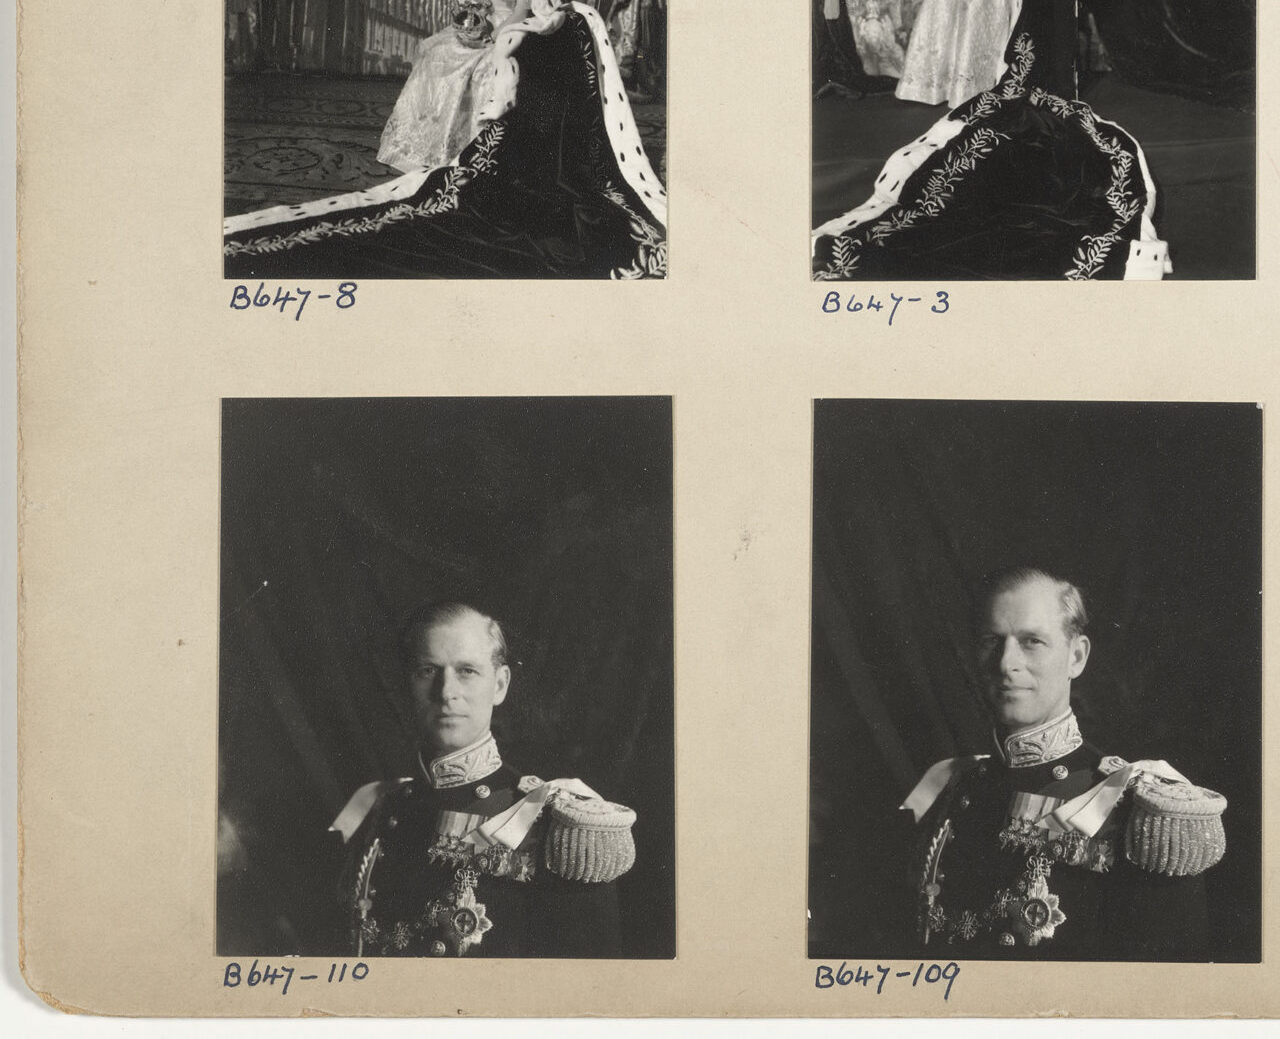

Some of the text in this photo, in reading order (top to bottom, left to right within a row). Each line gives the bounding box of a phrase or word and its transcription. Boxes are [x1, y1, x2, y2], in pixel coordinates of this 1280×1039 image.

[230, 282, 358, 322] B647-8
[822, 291, 950, 327] B647-3
[224, 960, 370, 996] B647-110
[815, 962, 961, 1001] B647-109
